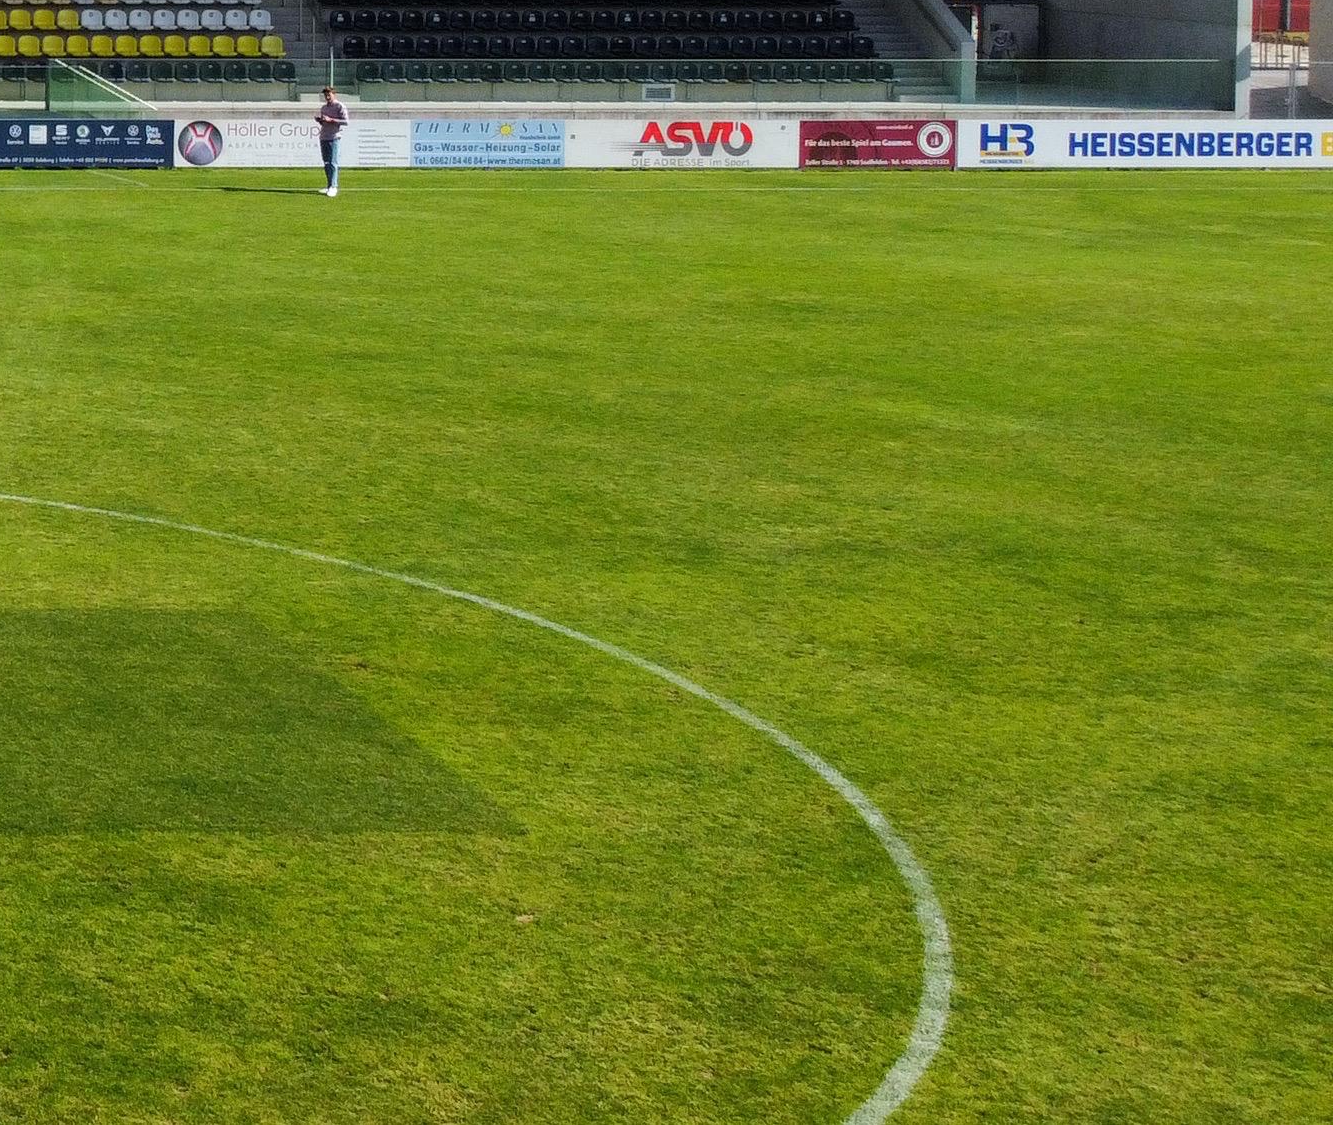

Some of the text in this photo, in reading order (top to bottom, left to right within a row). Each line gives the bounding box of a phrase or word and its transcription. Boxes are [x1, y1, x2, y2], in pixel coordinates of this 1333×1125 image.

[227, 122, 321, 139] Höller Grup
[805, 138, 817, 147] Für
[817, 139, 830, 147] das
[831, 138, 851, 147] beste
[851, 138, 869, 149] Spiel
[1069, 132, 1312, 156] HEISSENBERGER
[414, 157, 427, 165] Tel.
[631, 158, 651, 167] DIE
[653, 158, 704, 167] ADRESSE
